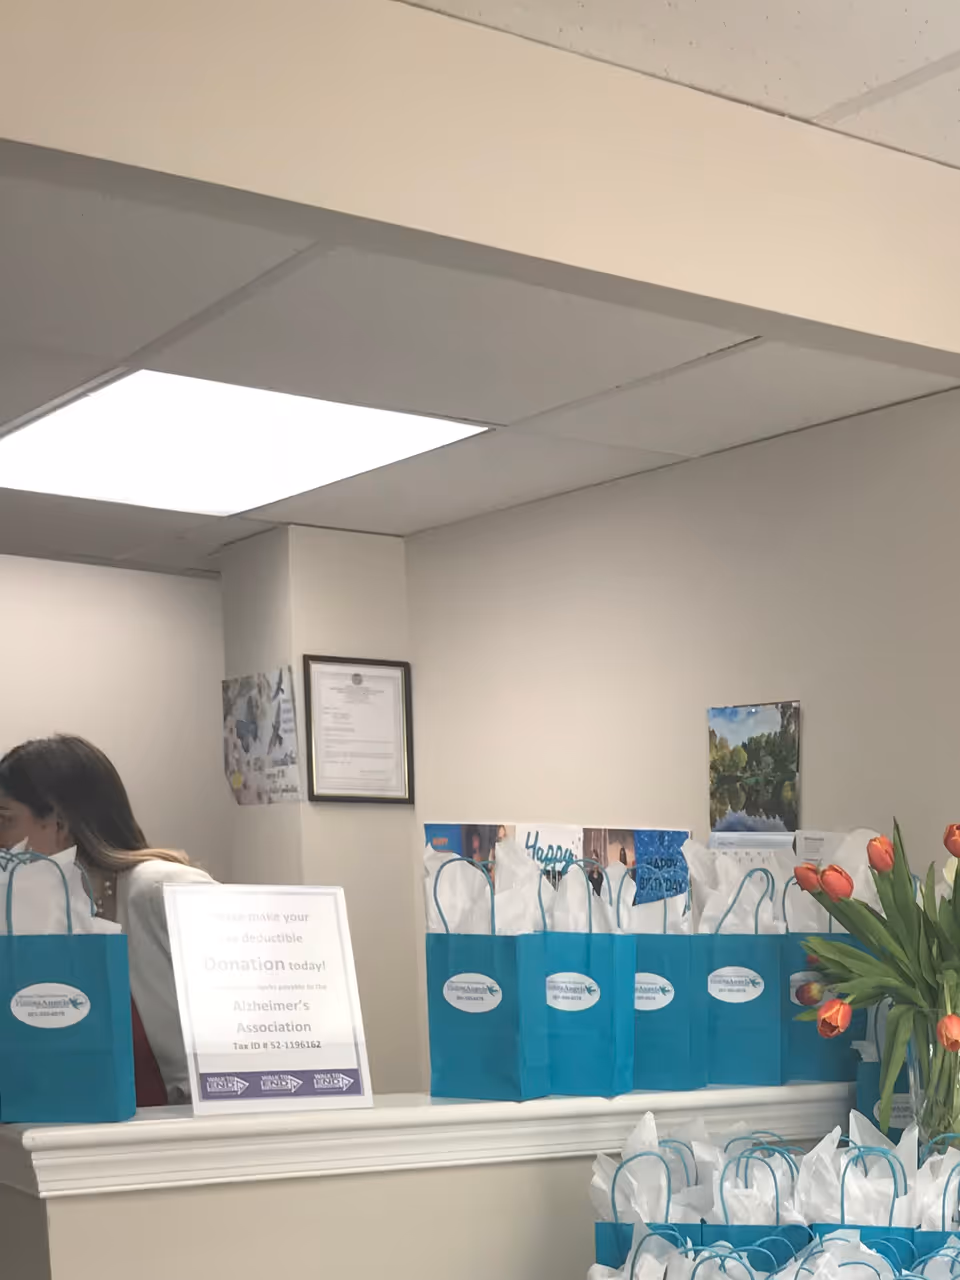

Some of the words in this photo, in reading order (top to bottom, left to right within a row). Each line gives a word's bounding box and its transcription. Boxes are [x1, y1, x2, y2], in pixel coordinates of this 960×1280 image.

[525, 831, 576, 875] Happy
[283, 912, 309, 925] your
[242, 931, 303, 944] deductible
[204, 955, 286, 972] Donation
[289, 960, 327, 973] today!
[233, 999, 311, 1012] Alzheimer's
[236, 1020, 312, 1034] Association
[233, 1041, 249, 1051] Tax
[250, 1041, 261, 1050] ID
[270, 1040, 322, 1050] 52-1196162
